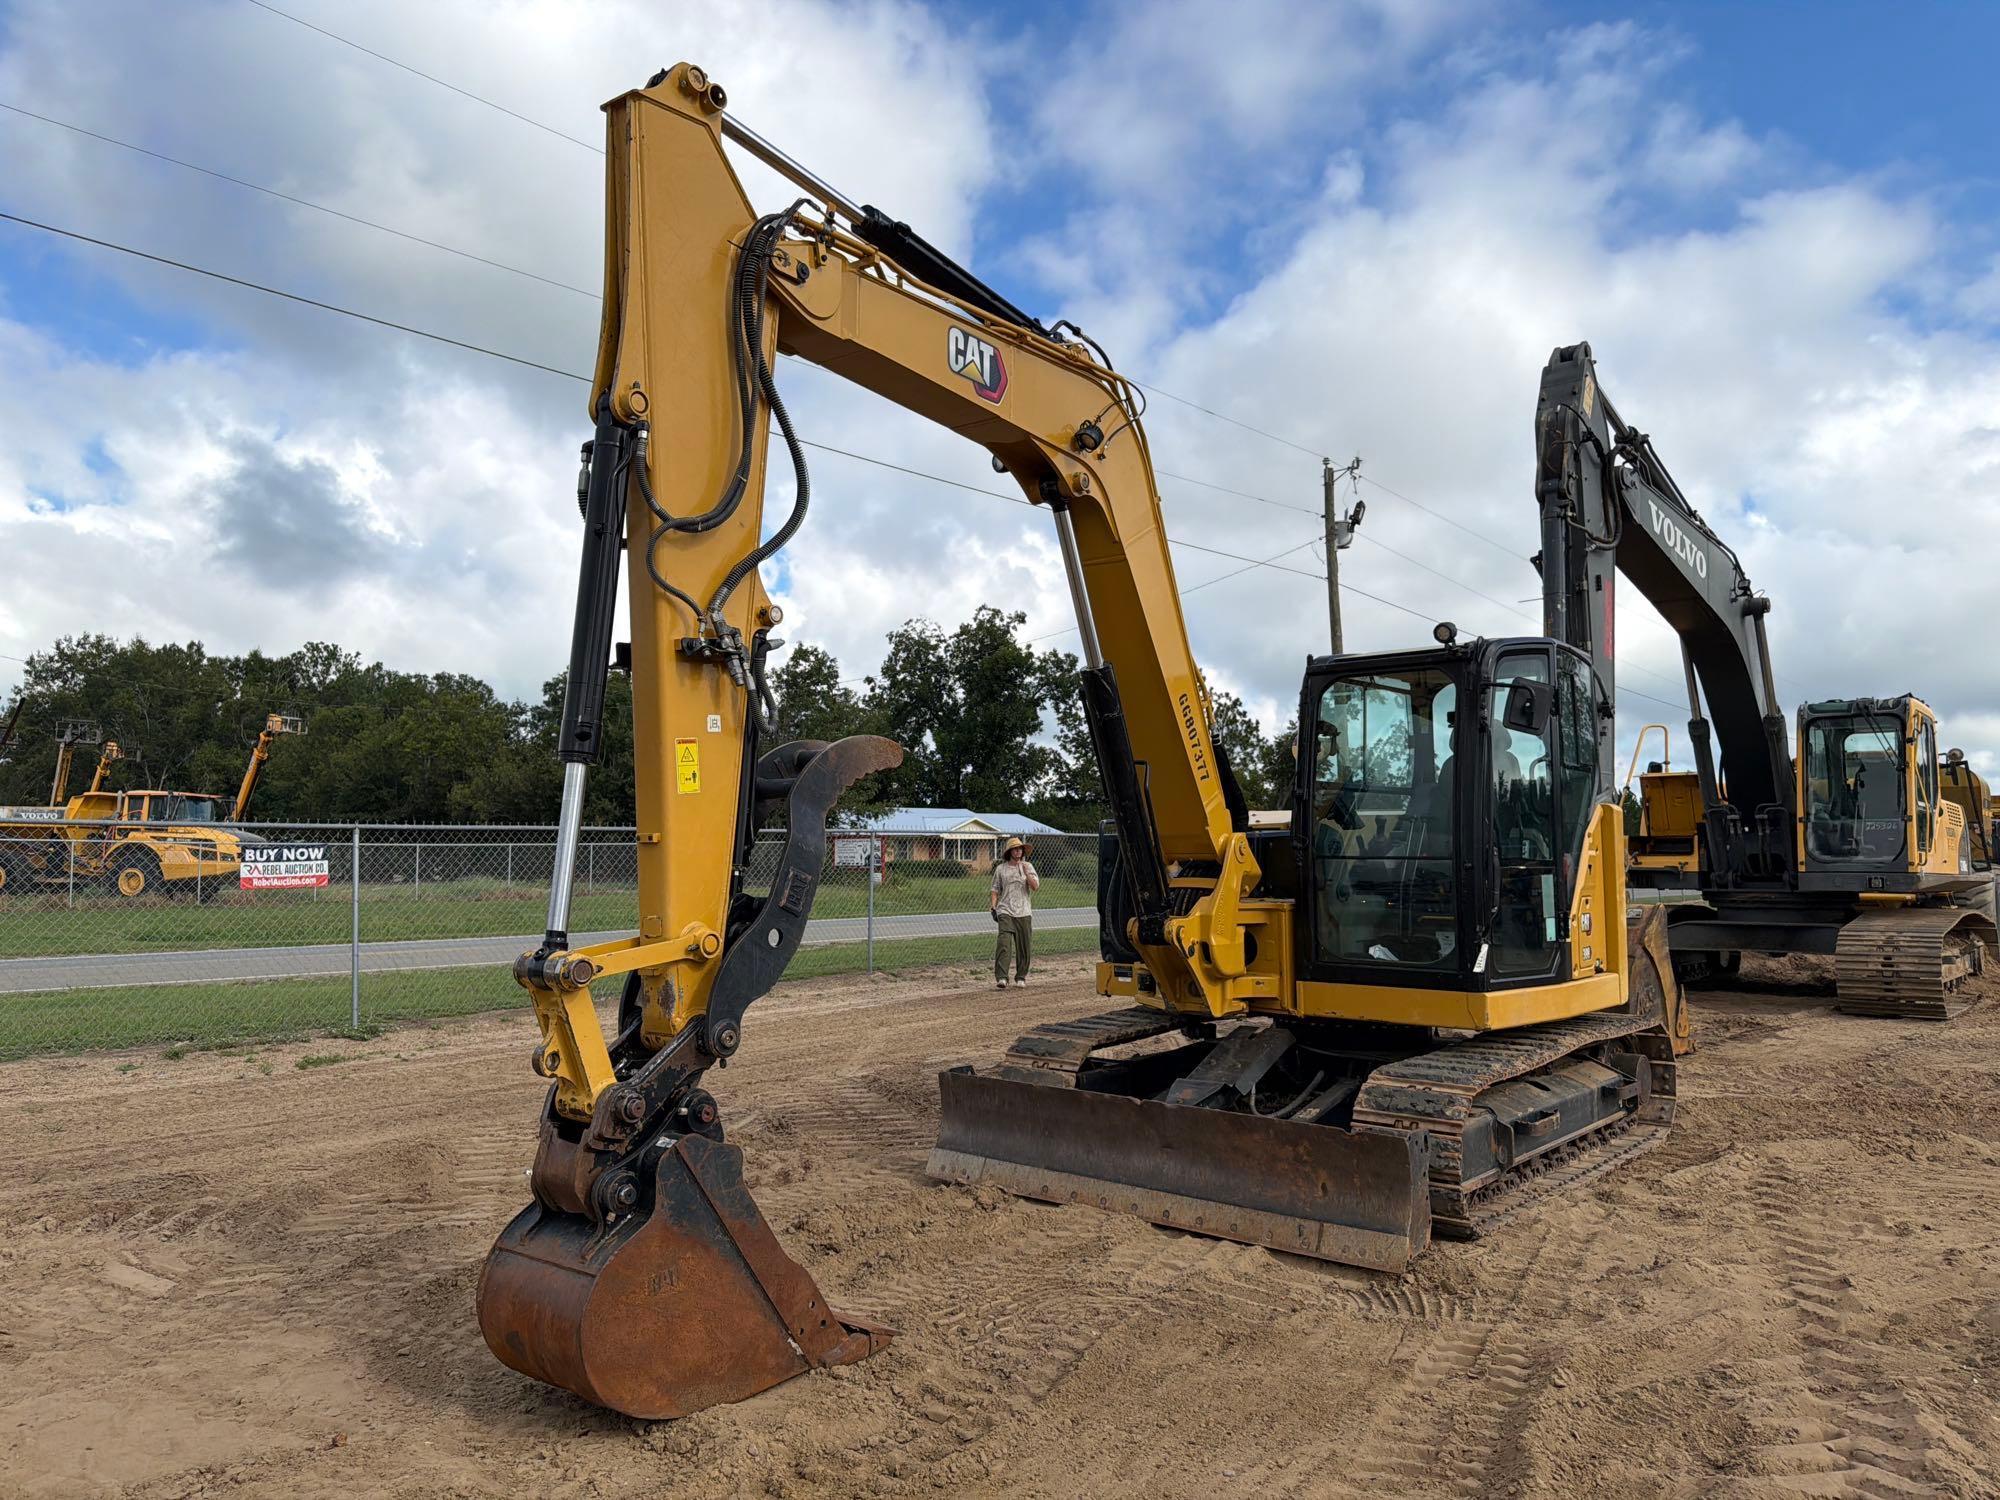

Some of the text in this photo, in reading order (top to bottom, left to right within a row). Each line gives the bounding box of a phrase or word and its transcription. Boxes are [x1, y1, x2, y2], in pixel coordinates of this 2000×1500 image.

[949, 327, 994, 387] CAT
[1648, 499, 1707, 578] VOLVO
[21, 812, 58, 820] VOLVO
[245, 847, 324, 861] BUY NOW
[262, 865, 282, 875] REBEL
[284, 863, 313, 874] AUCTION
[315, 863, 326, 873] CO.
[252, 877, 317, 887] RebelAuction.com
